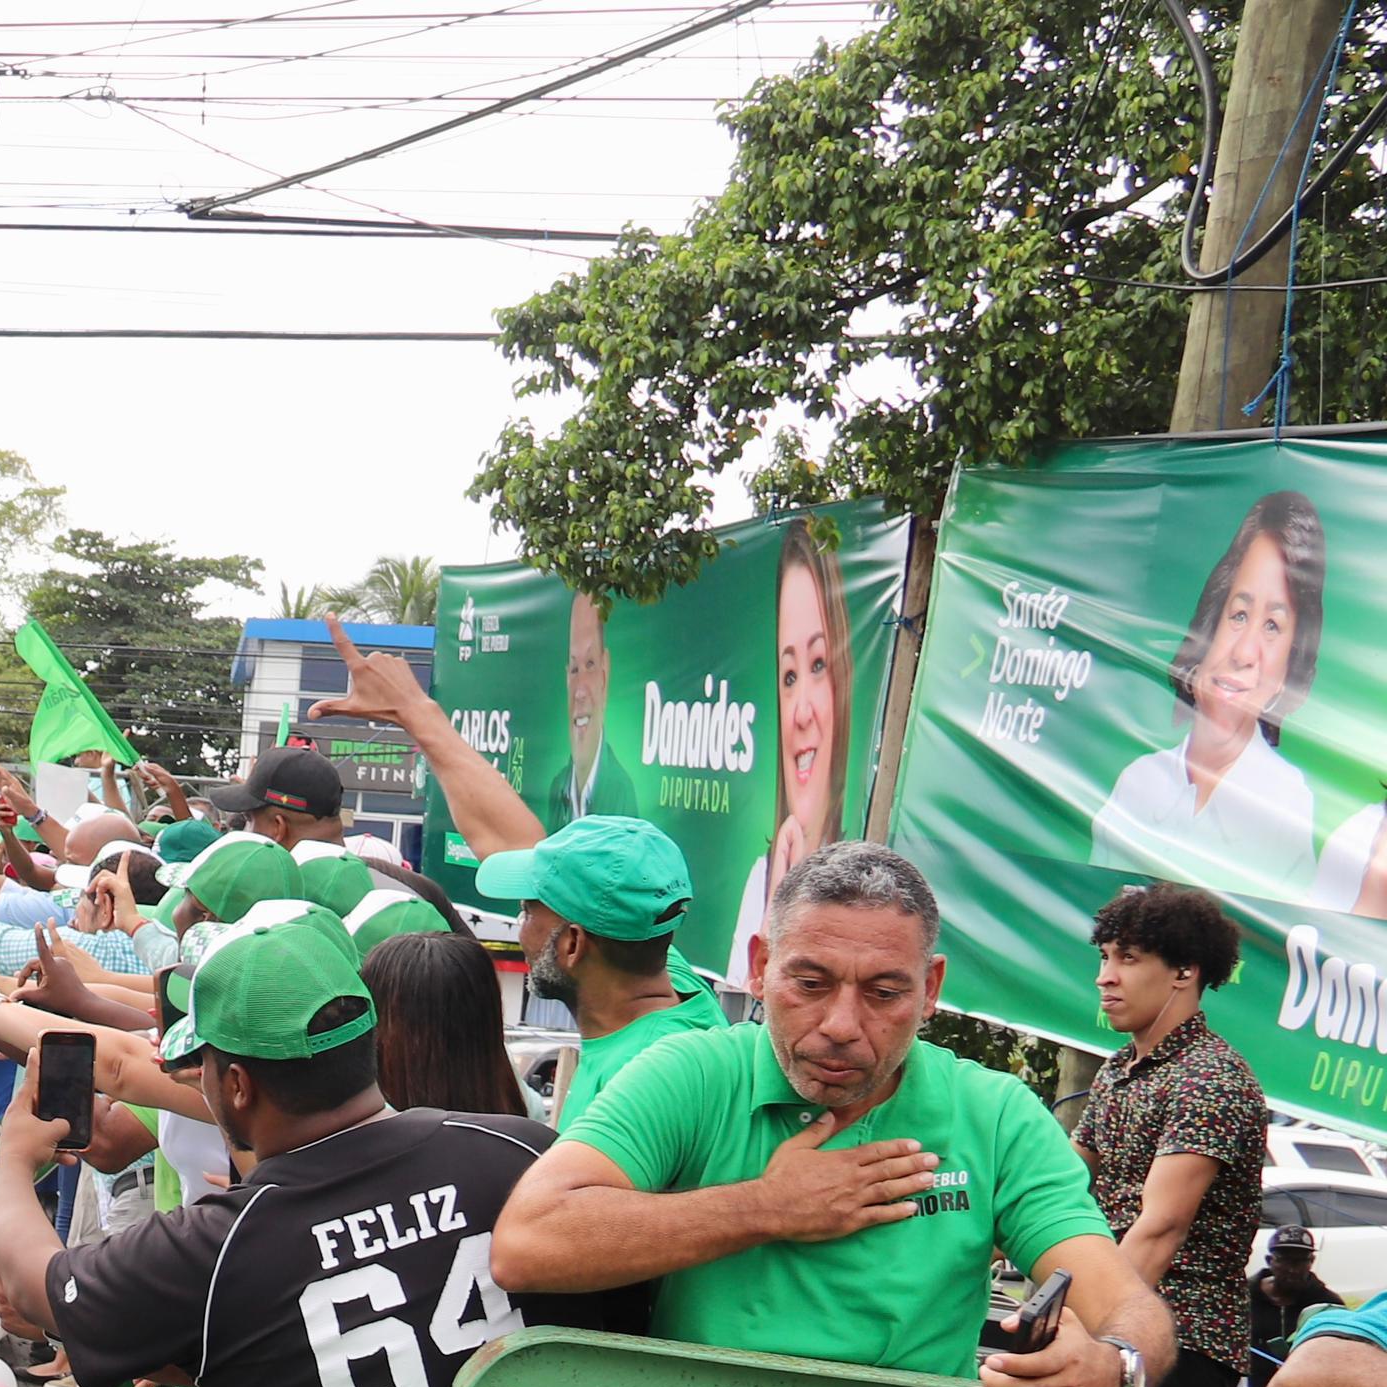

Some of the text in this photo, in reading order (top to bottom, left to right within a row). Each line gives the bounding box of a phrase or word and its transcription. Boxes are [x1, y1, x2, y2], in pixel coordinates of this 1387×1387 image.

[481, 615, 500, 632] FUERZA
[998, 581, 1069, 629] Santo
[458, 647, 472, 662] FP
[481, 634, 491, 652] DEL
[989, 636, 1091, 701] Domingo
[641, 673, 756, 773] Danaides
[977, 692, 1045, 743] Norte
[513, 737, 525, 765] 24
[511, 766, 523, 794] 28
[659, 775, 730, 814] DIPUTADA
[1310, 1051, 1387, 1113] DIPU
[932, 1170, 968, 1188] EBLO
[311, 1184, 467, 1270] FELIZ
